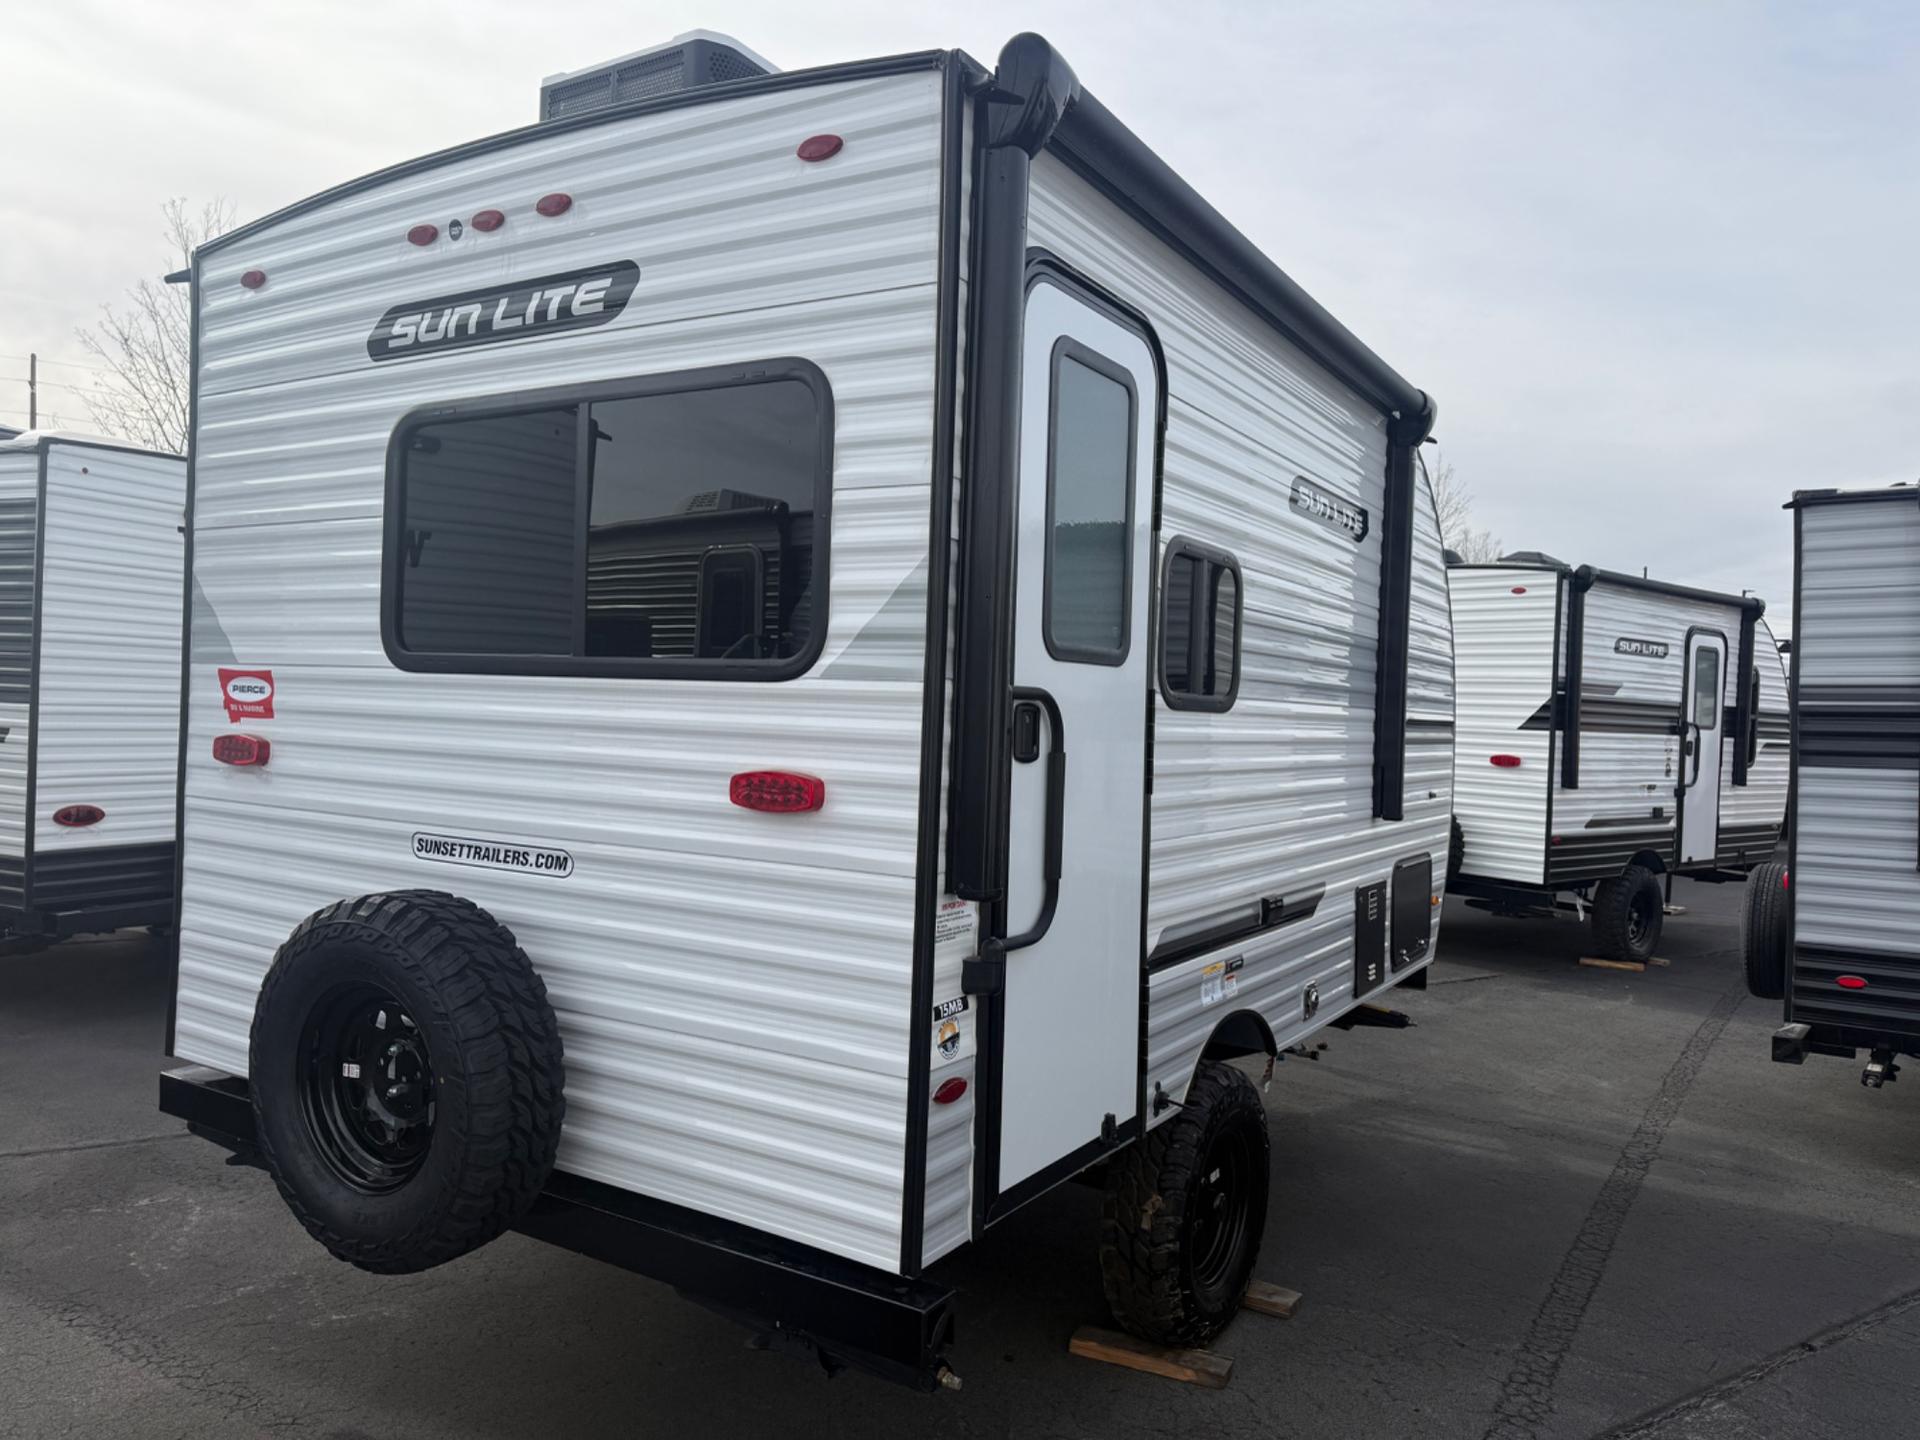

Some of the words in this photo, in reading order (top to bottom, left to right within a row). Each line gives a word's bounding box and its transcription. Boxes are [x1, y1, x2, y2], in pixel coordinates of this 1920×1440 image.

[387, 303, 482, 348] SUN
[492, 277, 613, 331] LITE
[1332, 503, 1363, 533] LITE
[1642, 643, 1665, 656] LITE
[231, 684, 266, 694] PIERCE
[416, 838, 568, 871] SUNSETTRAILERS.COM
[940, 999, 964, 1018] 15MB
